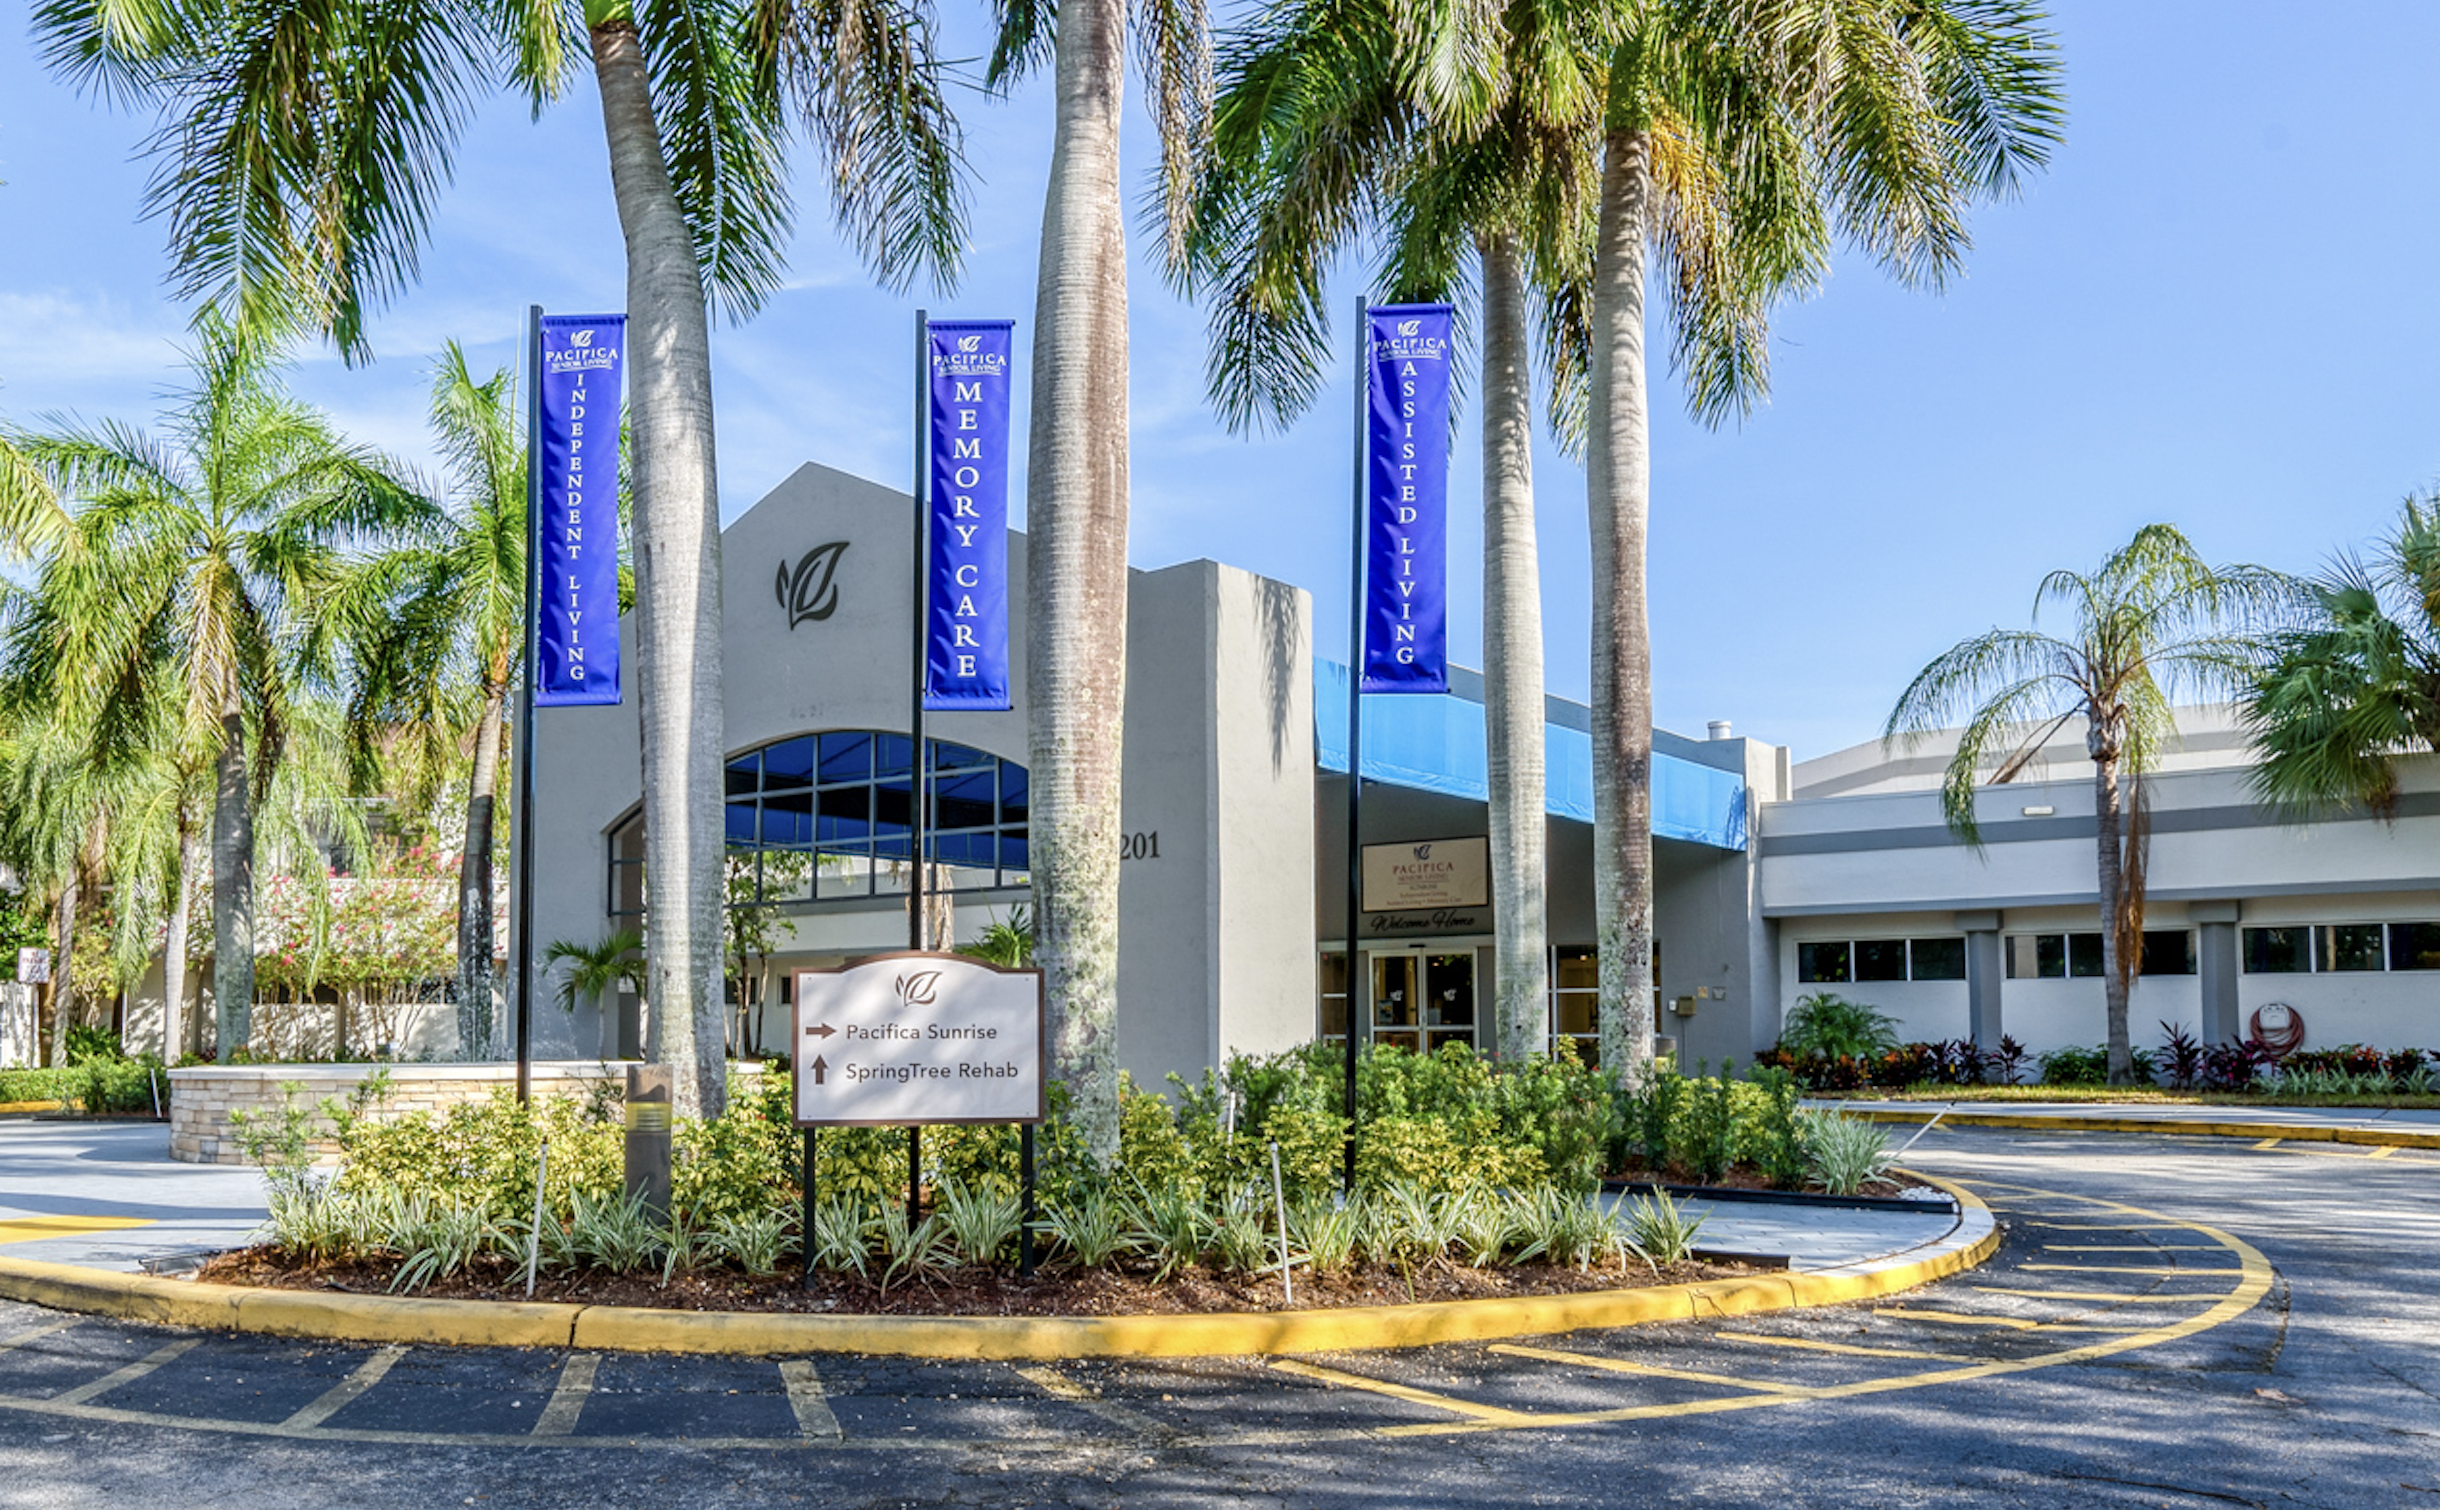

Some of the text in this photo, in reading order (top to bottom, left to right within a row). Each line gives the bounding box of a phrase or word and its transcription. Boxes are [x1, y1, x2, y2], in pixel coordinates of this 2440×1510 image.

[1373, 337, 1448, 352] PACIFICA
[545, 347, 618, 362] PACIFICA
[933, 353, 1007, 366] PACIFICA
[1396, 360, 1418, 664] ASSISTED LIVING
[567, 373, 586, 680] INDEPENDENT LIVING
[953, 381, 983, 677] MEMORY CARE
[1393, 862, 1454, 875] PACIFICA
[1371, 909, 1475, 931] Welcome Home
[846, 1023, 997, 1040] Pacifica Sunrise
[846, 1061, 1018, 1083] SpringTree Rehab
